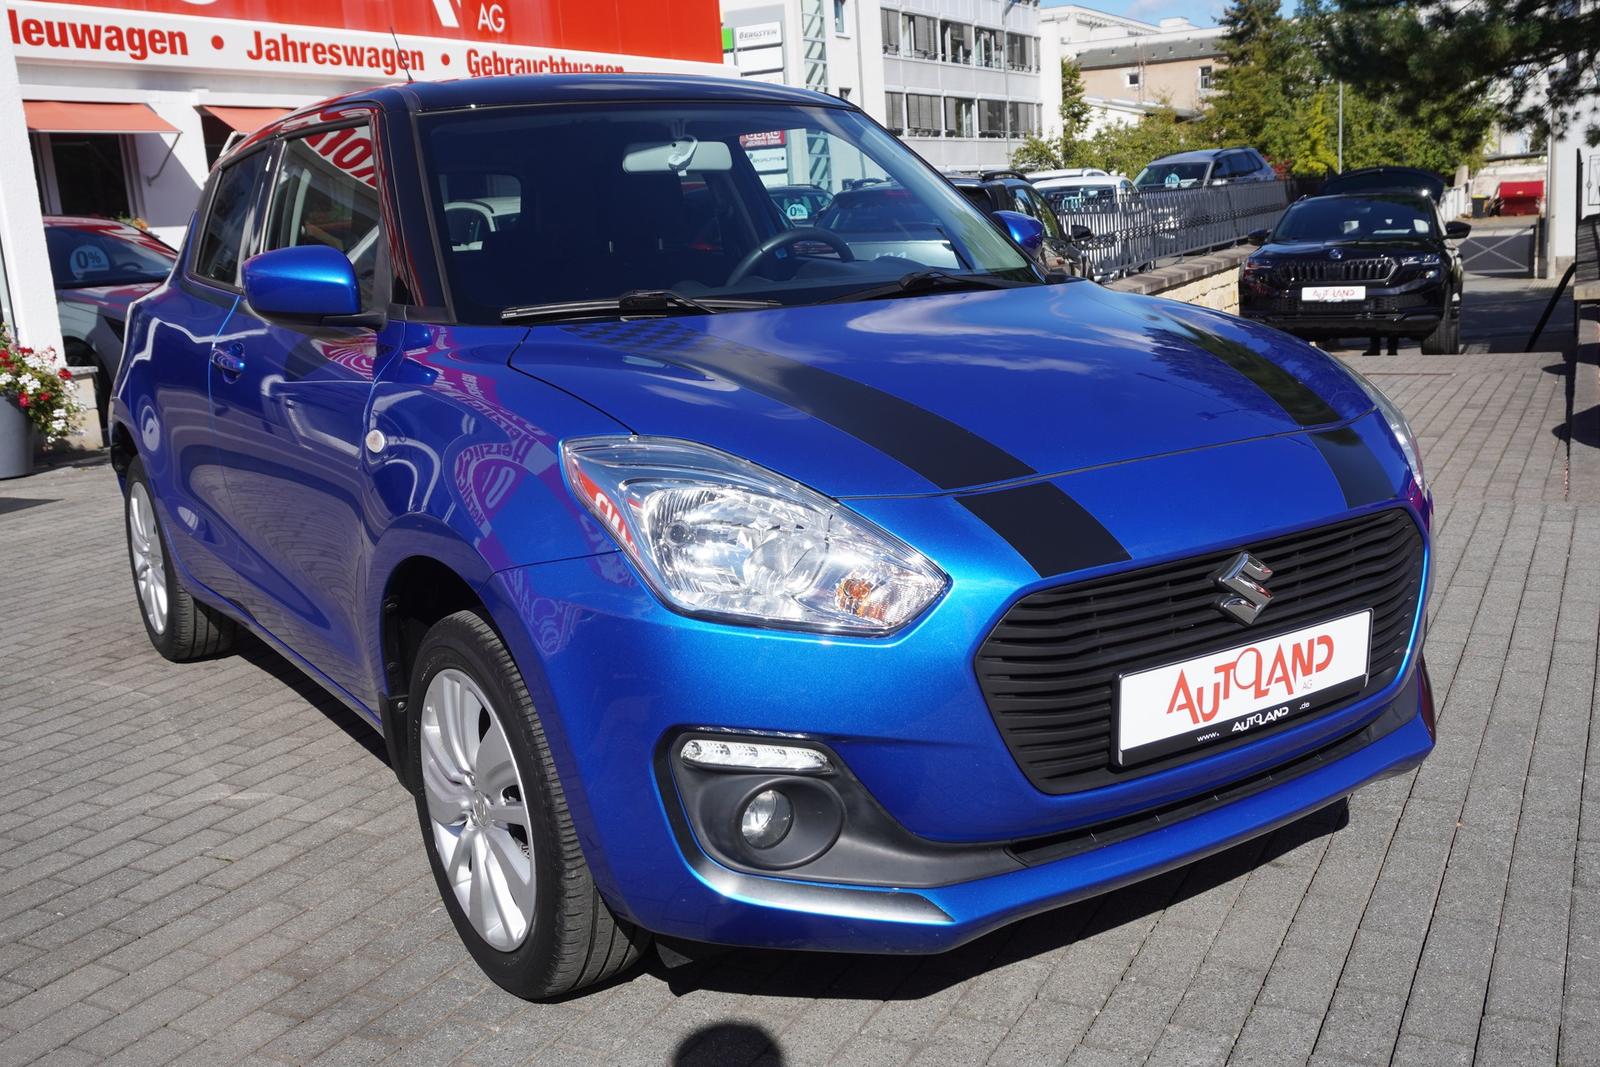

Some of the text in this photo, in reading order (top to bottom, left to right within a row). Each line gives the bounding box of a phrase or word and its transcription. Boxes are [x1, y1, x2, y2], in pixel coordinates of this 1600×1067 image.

[477, 3, 506, 32] AG
[247, 30, 424, 76] Jahreswagen
[76, 250, 102, 269] 0%
[1312, 288, 1356, 299] AUTLAND
[1167, 634, 1334, 725] AUTOLAND
[1302, 679, 1313, 690] AG
[1197, 731, 1220, 743] www.
[1231, 706, 1289, 732] AUTOLAND
